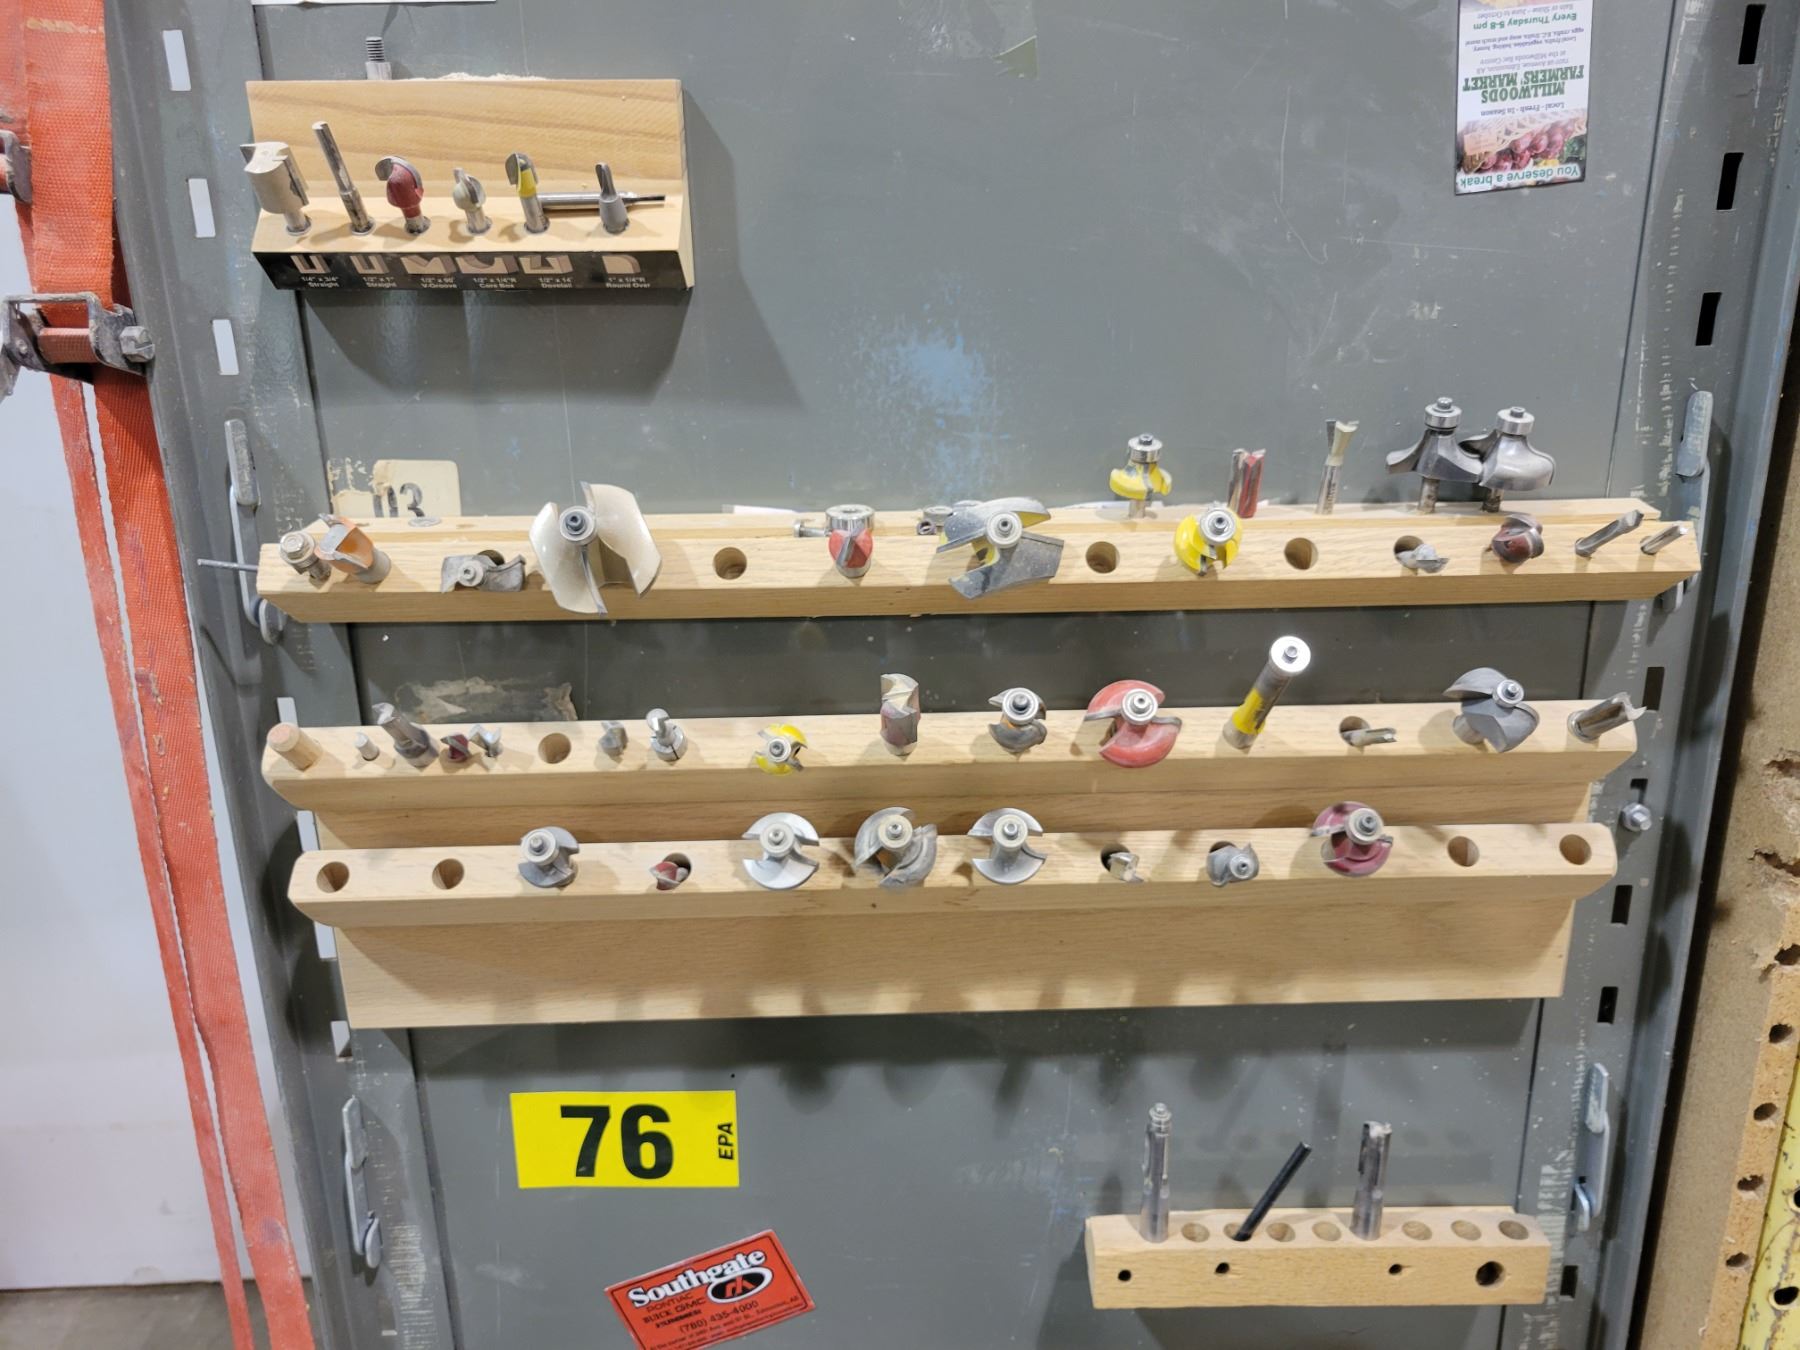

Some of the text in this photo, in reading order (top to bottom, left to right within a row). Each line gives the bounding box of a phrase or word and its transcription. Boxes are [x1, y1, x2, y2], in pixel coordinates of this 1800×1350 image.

[1507, 16, 1550, 27] Thursday
[1463, 65, 1584, 91] FARMERS' MARKET
[1481, 82, 1565, 103] MILLWOODS
[1481, 108, 1504, 116] Season
[1507, 168, 1553, 180] deserve
[1557, 166, 1578, 176] You
[1460, 176, 1492, 187] break
[560, 1103, 674, 1180] 76
[717, 1122, 734, 1160] EPA
[628, 1250, 766, 1308] Southgate
[643, 1297, 706, 1324] BUICK GMC
[646, 1293, 693, 1312] PONTIAC
[679, 1319, 708, 1333] (780)
